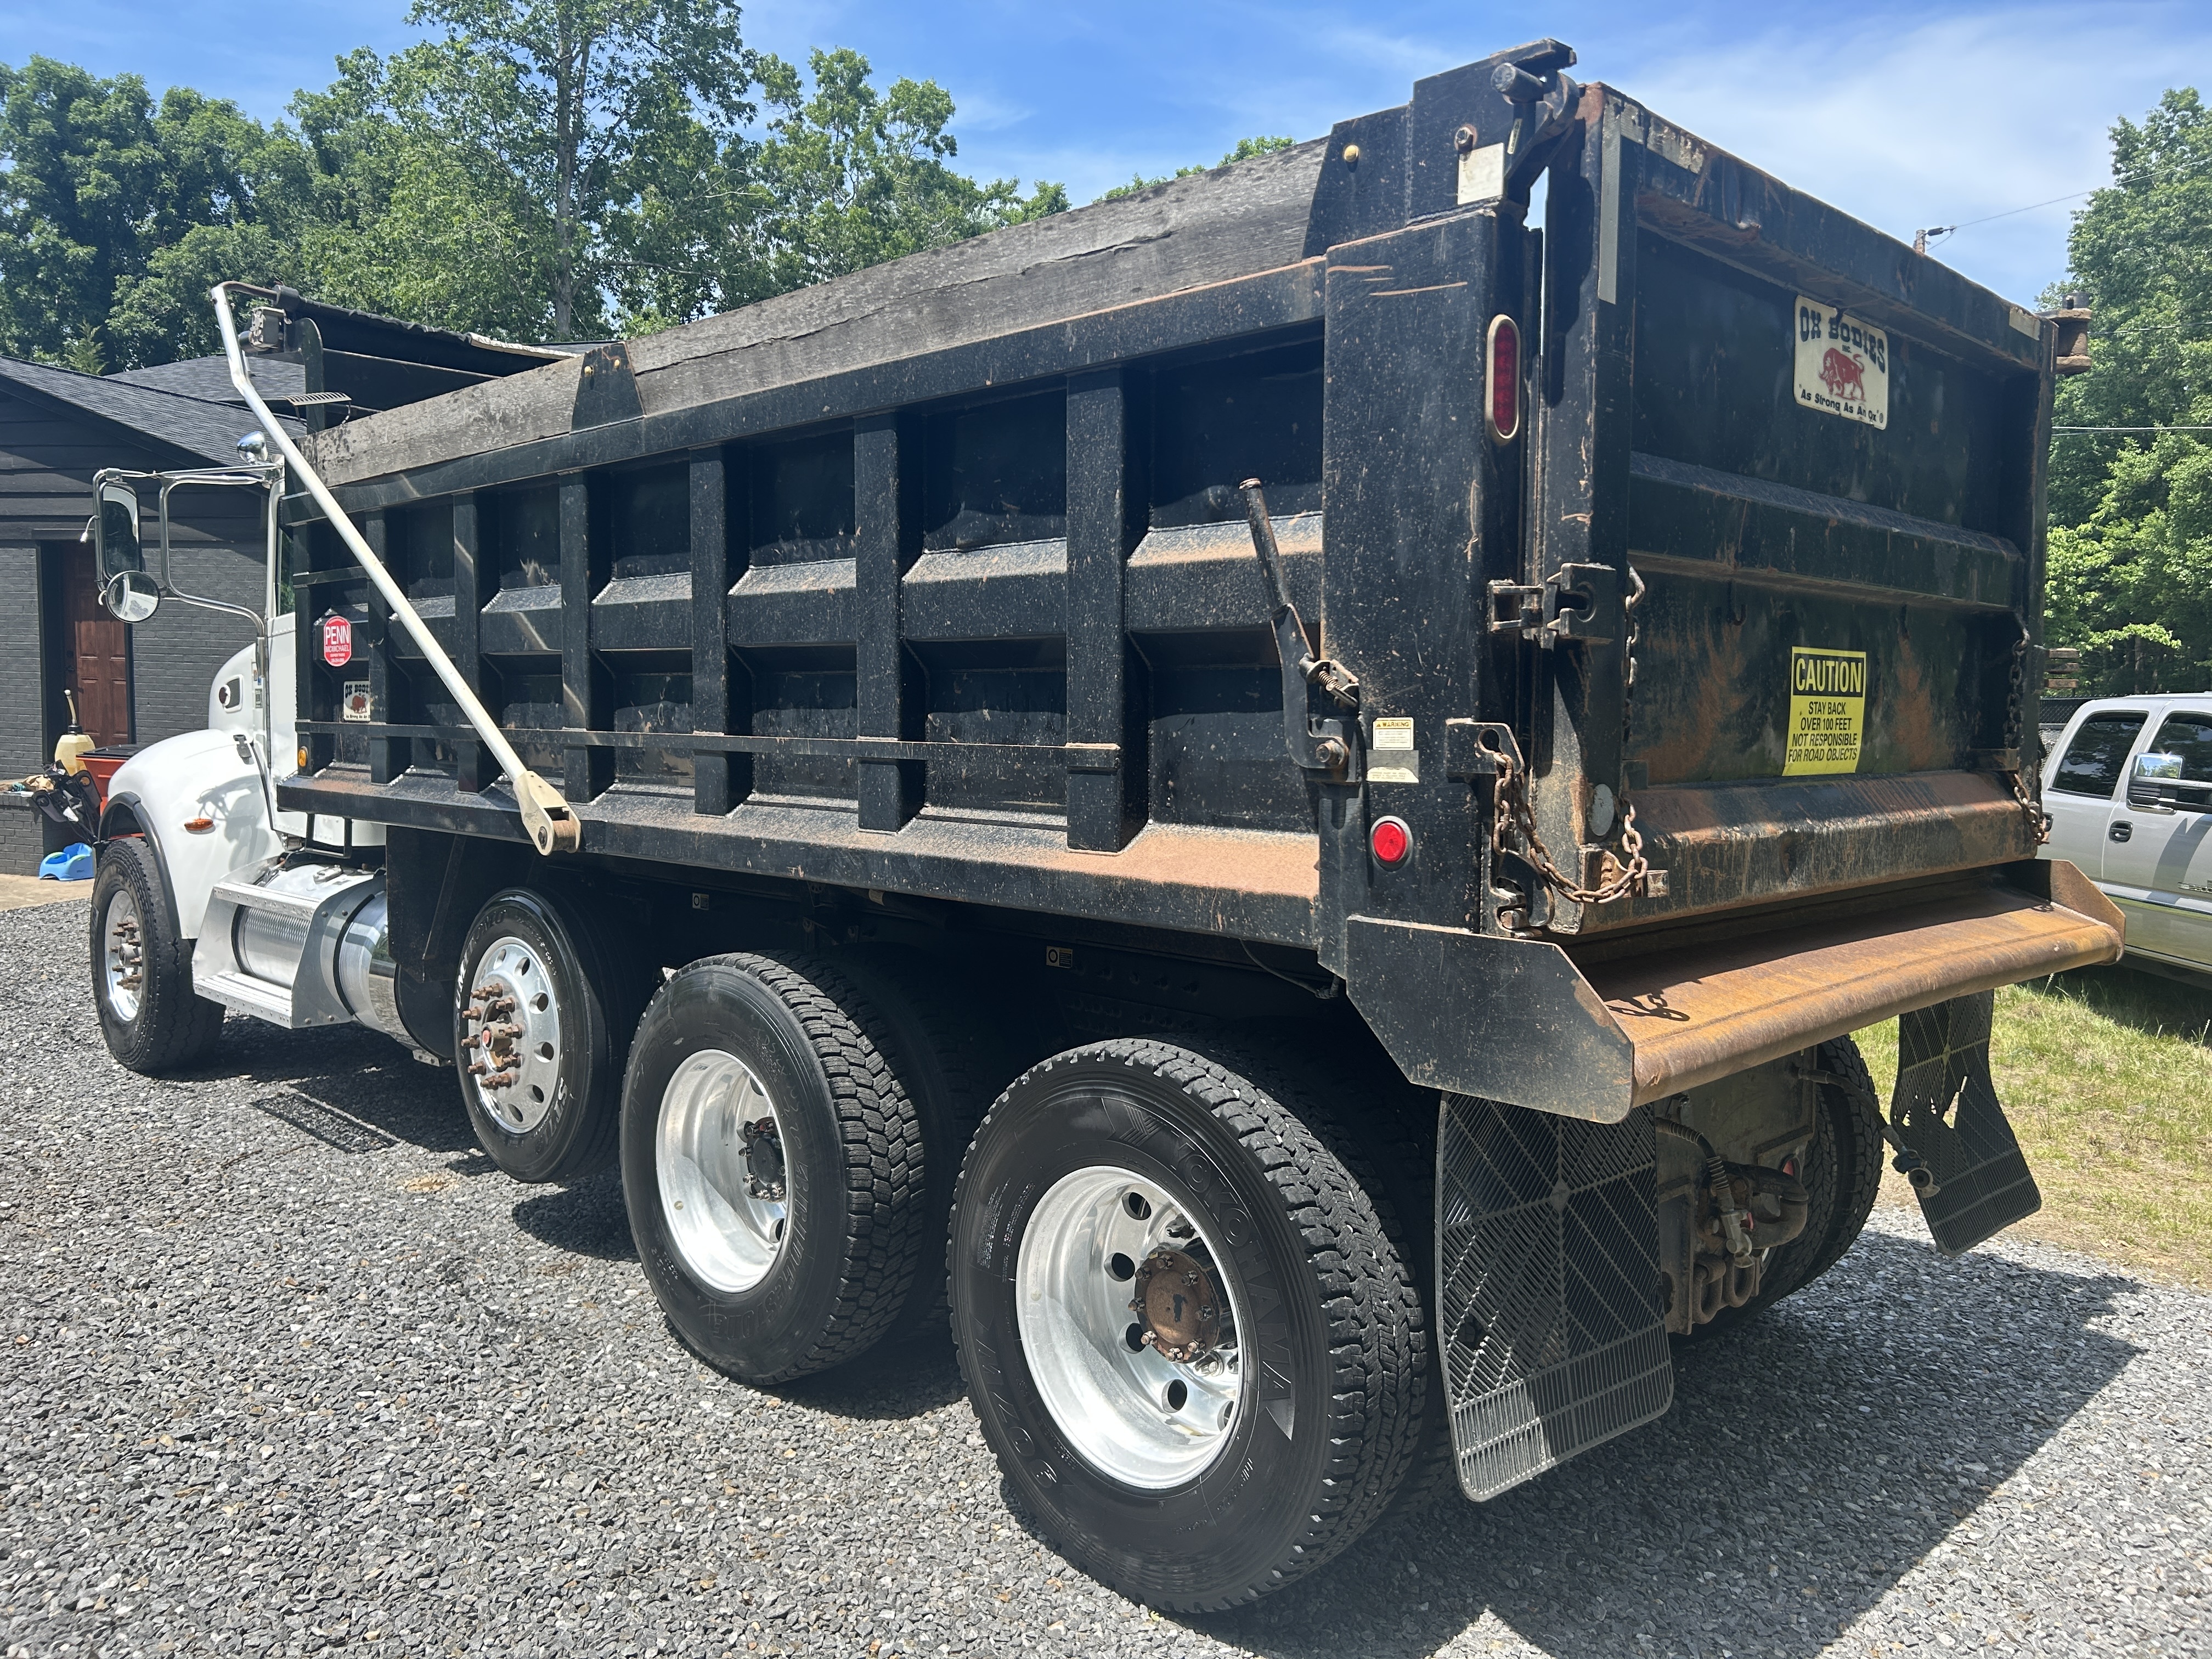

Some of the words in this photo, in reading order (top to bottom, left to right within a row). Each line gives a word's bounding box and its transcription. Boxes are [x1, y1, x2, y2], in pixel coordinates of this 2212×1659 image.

[1799, 306, 1821, 342] OX
[1829, 317, 1885, 374] BODIES
[1815, 393, 1840, 411] Strong
[1844, 403, 1853, 413] As
[1857, 407, 1866, 417] An
[325, 625, 349, 645] PENN
[1796, 658, 1861, 693] CAUTION
[354, 684, 370, 695] BODI
[1809, 701, 1826, 715] STAY
[1827, 702, 1846, 715] BACK
[1801, 718, 1820, 730] OVER
[1822, 718, 1833, 730] 100
[1835, 718, 1852, 730] FEET
[1792, 733, 1809, 746] NOT
[1809, 733, 1857, 746] RESPONSIBLE
[1788, 749, 1802, 762] FOR
[1803, 749, 1825, 761] ROAD
[1827, 748, 1858, 760] OBJECTS
[1170, 1131, 1293, 1401] YOKOHAMA
